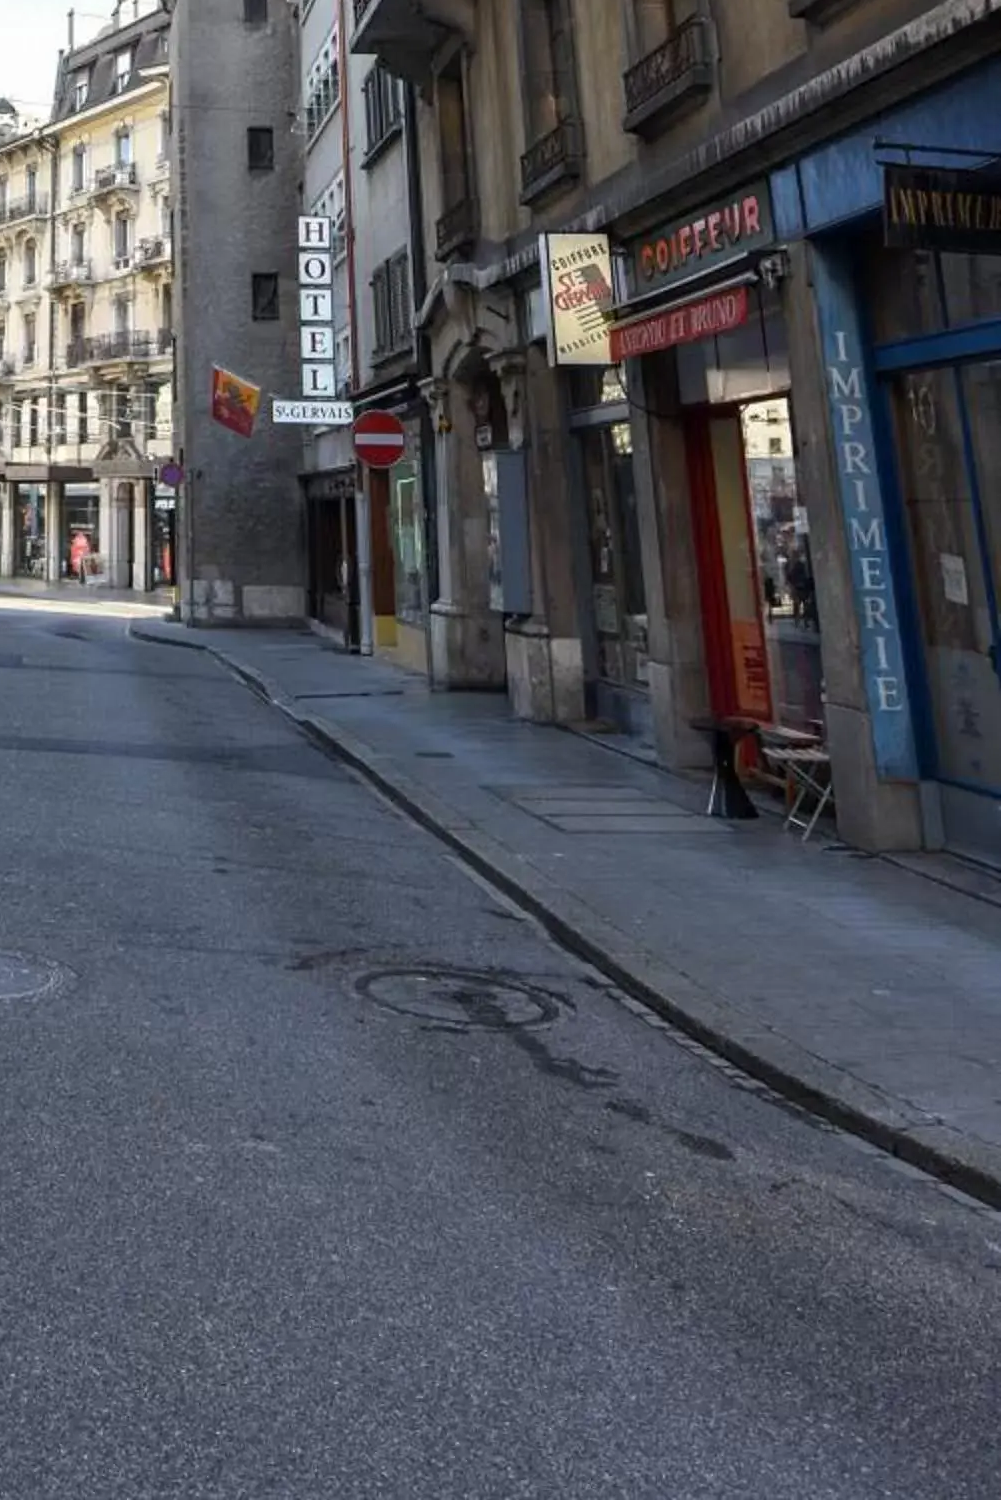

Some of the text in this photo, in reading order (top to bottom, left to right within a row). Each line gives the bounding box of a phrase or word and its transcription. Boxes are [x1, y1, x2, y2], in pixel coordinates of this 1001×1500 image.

[552, 243, 607, 271] COIFFURE
[641, 196, 760, 281] COIFFEUR
[304, 221, 328, 392] HOTEL
[670, 311, 687, 343] ET
[690, 295, 737, 335] BRUNO
[828, 331, 903, 712] IMPRIMERIE
